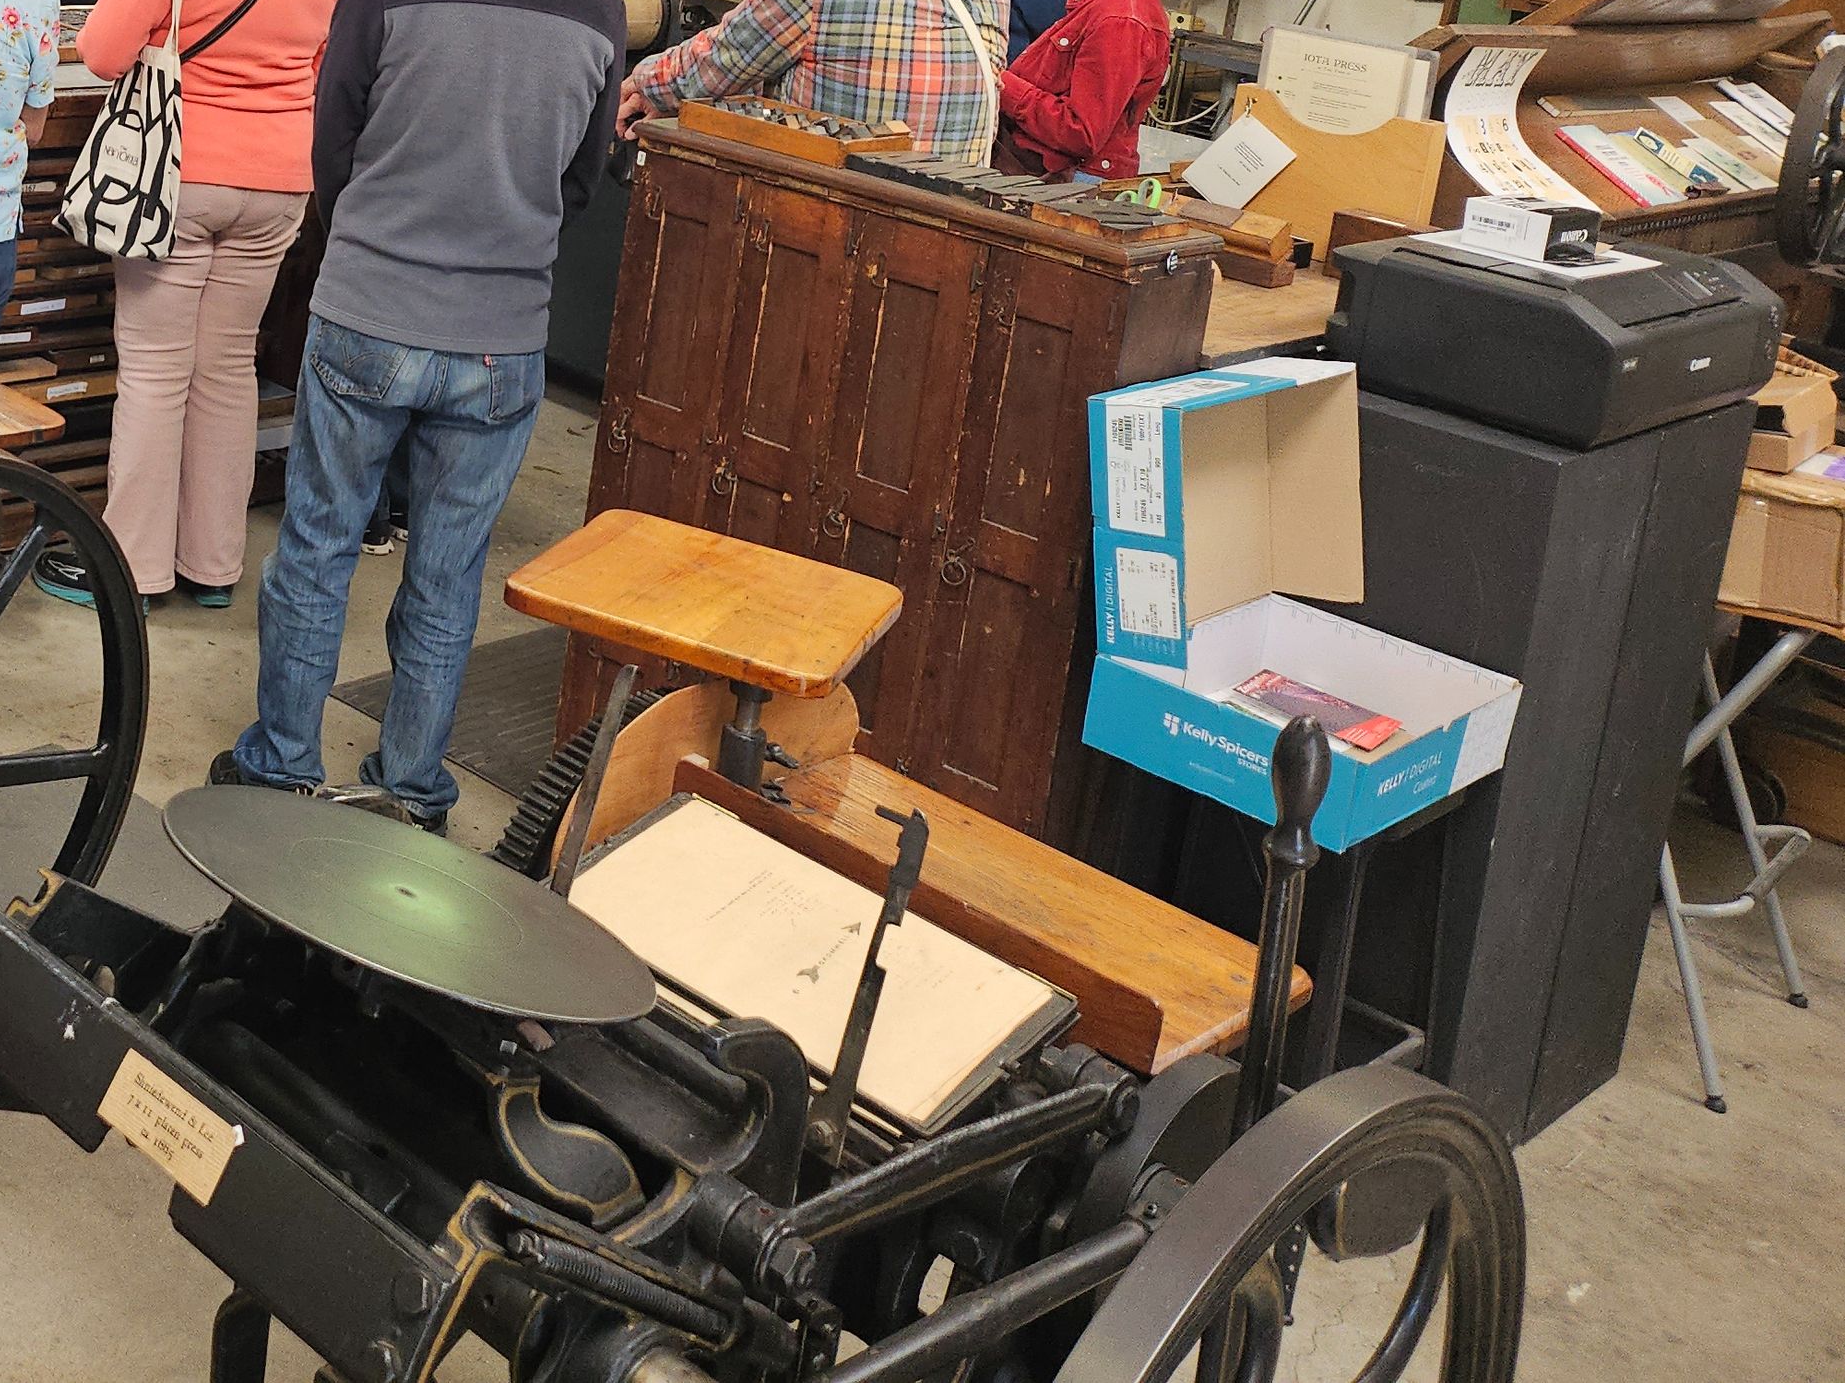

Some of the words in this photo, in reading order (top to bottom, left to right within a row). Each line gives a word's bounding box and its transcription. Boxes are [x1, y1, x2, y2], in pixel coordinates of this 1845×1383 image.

[1304, 54, 1330, 66] IOTA
[1333, 59, 1368, 73] PRESS
[1465, 49, 1538, 87] MAY
[1561, 229, 1588, 243] Canon
[1104, 567, 1113, 605] DIGITAL
[1105, 610, 1115, 644] KELLY
[1378, 770, 1406, 796] KELLY
[1408, 752, 1442, 781] DIGITAL
[198, 1122, 214, 1142] Lee
[181, 1138, 204, 1159] press
